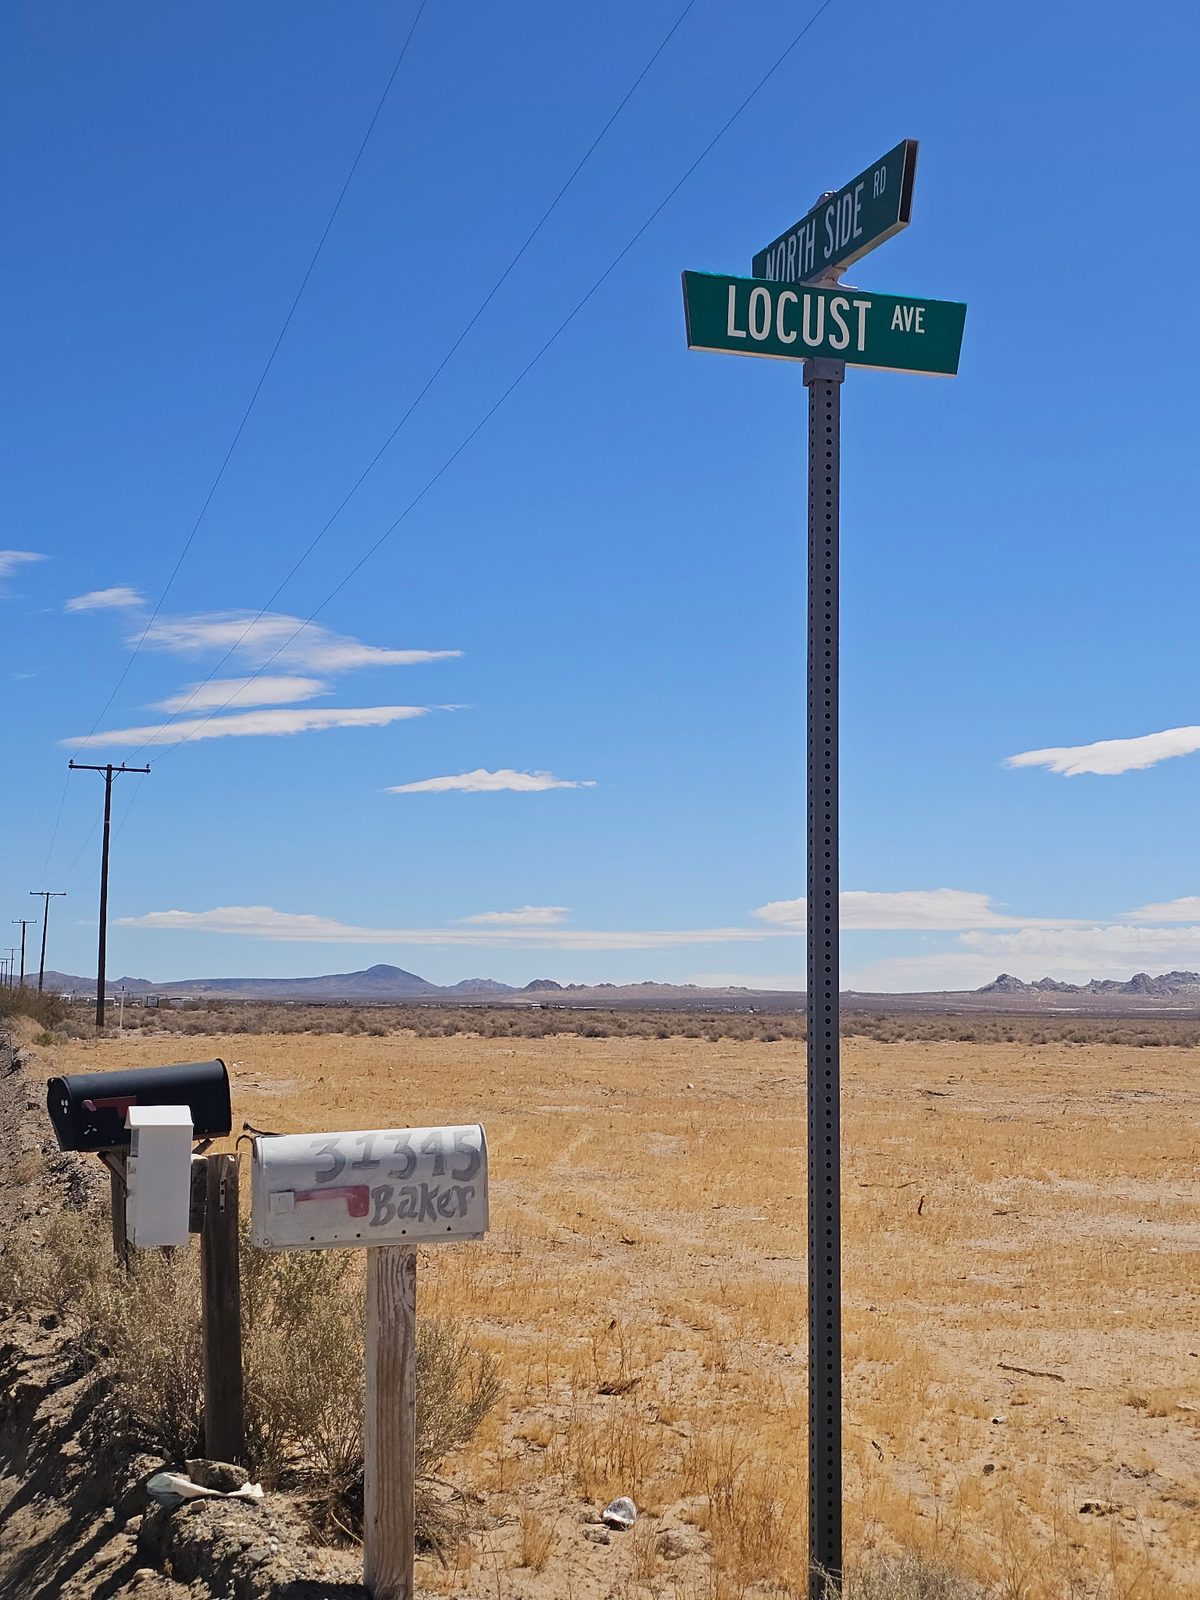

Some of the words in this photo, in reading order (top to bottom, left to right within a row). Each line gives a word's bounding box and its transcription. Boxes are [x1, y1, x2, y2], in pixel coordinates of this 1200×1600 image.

[765, 218, 816, 281] NORTH
[823, 181, 865, 259] SIDE
[873, 165, 887, 199] RD
[727, 284, 872, 351] LOCUST
[890, 304, 926, 333] AVE
[369, 1182, 476, 1227] Baker
